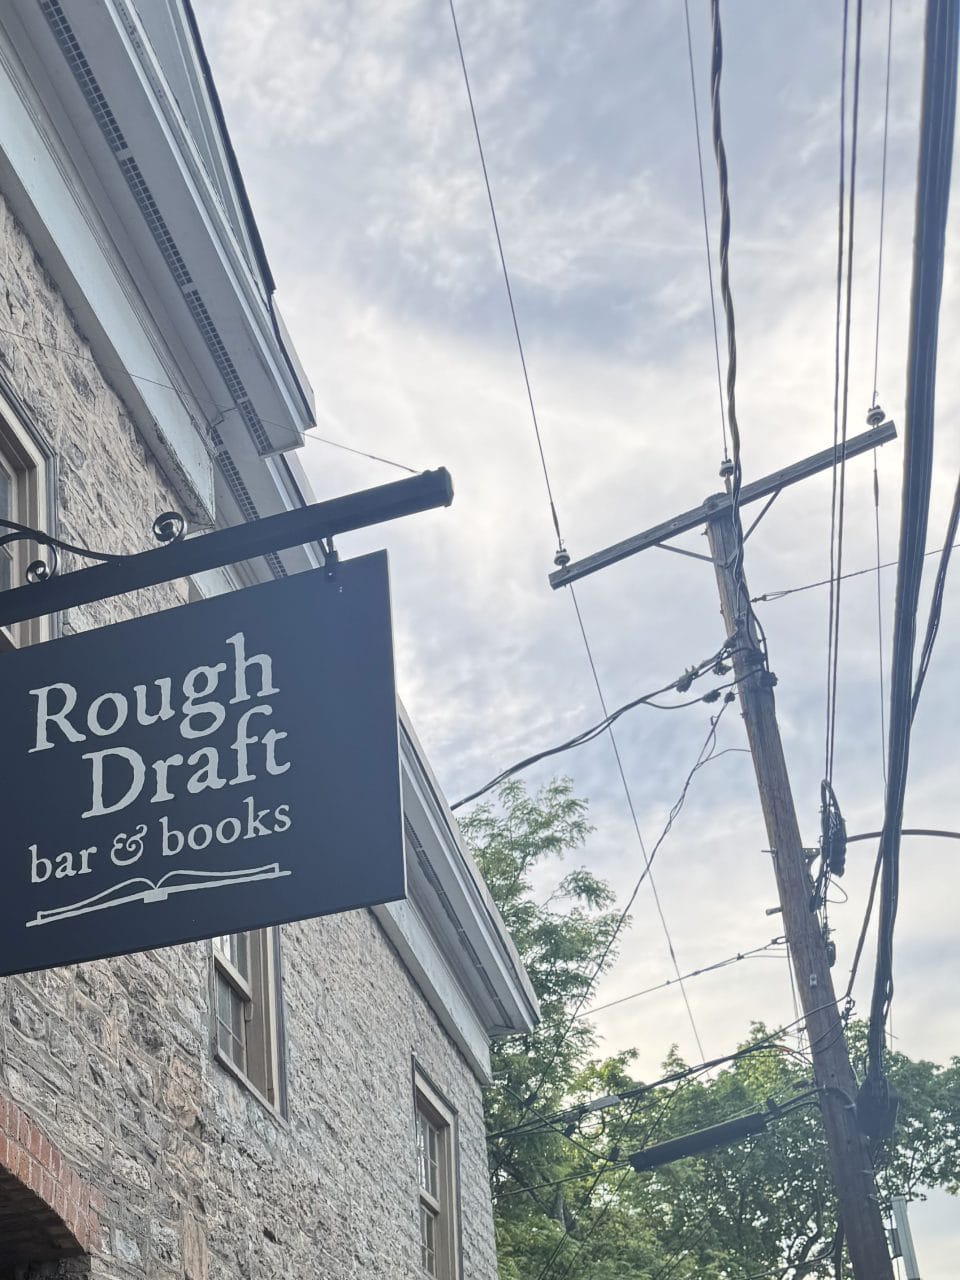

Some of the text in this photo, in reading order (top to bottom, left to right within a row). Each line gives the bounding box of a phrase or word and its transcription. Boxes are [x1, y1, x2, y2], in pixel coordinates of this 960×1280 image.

[28, 632, 280, 753] Rough
[82, 704, 291, 818] Draft
[28, 796, 292, 883] bar & books
